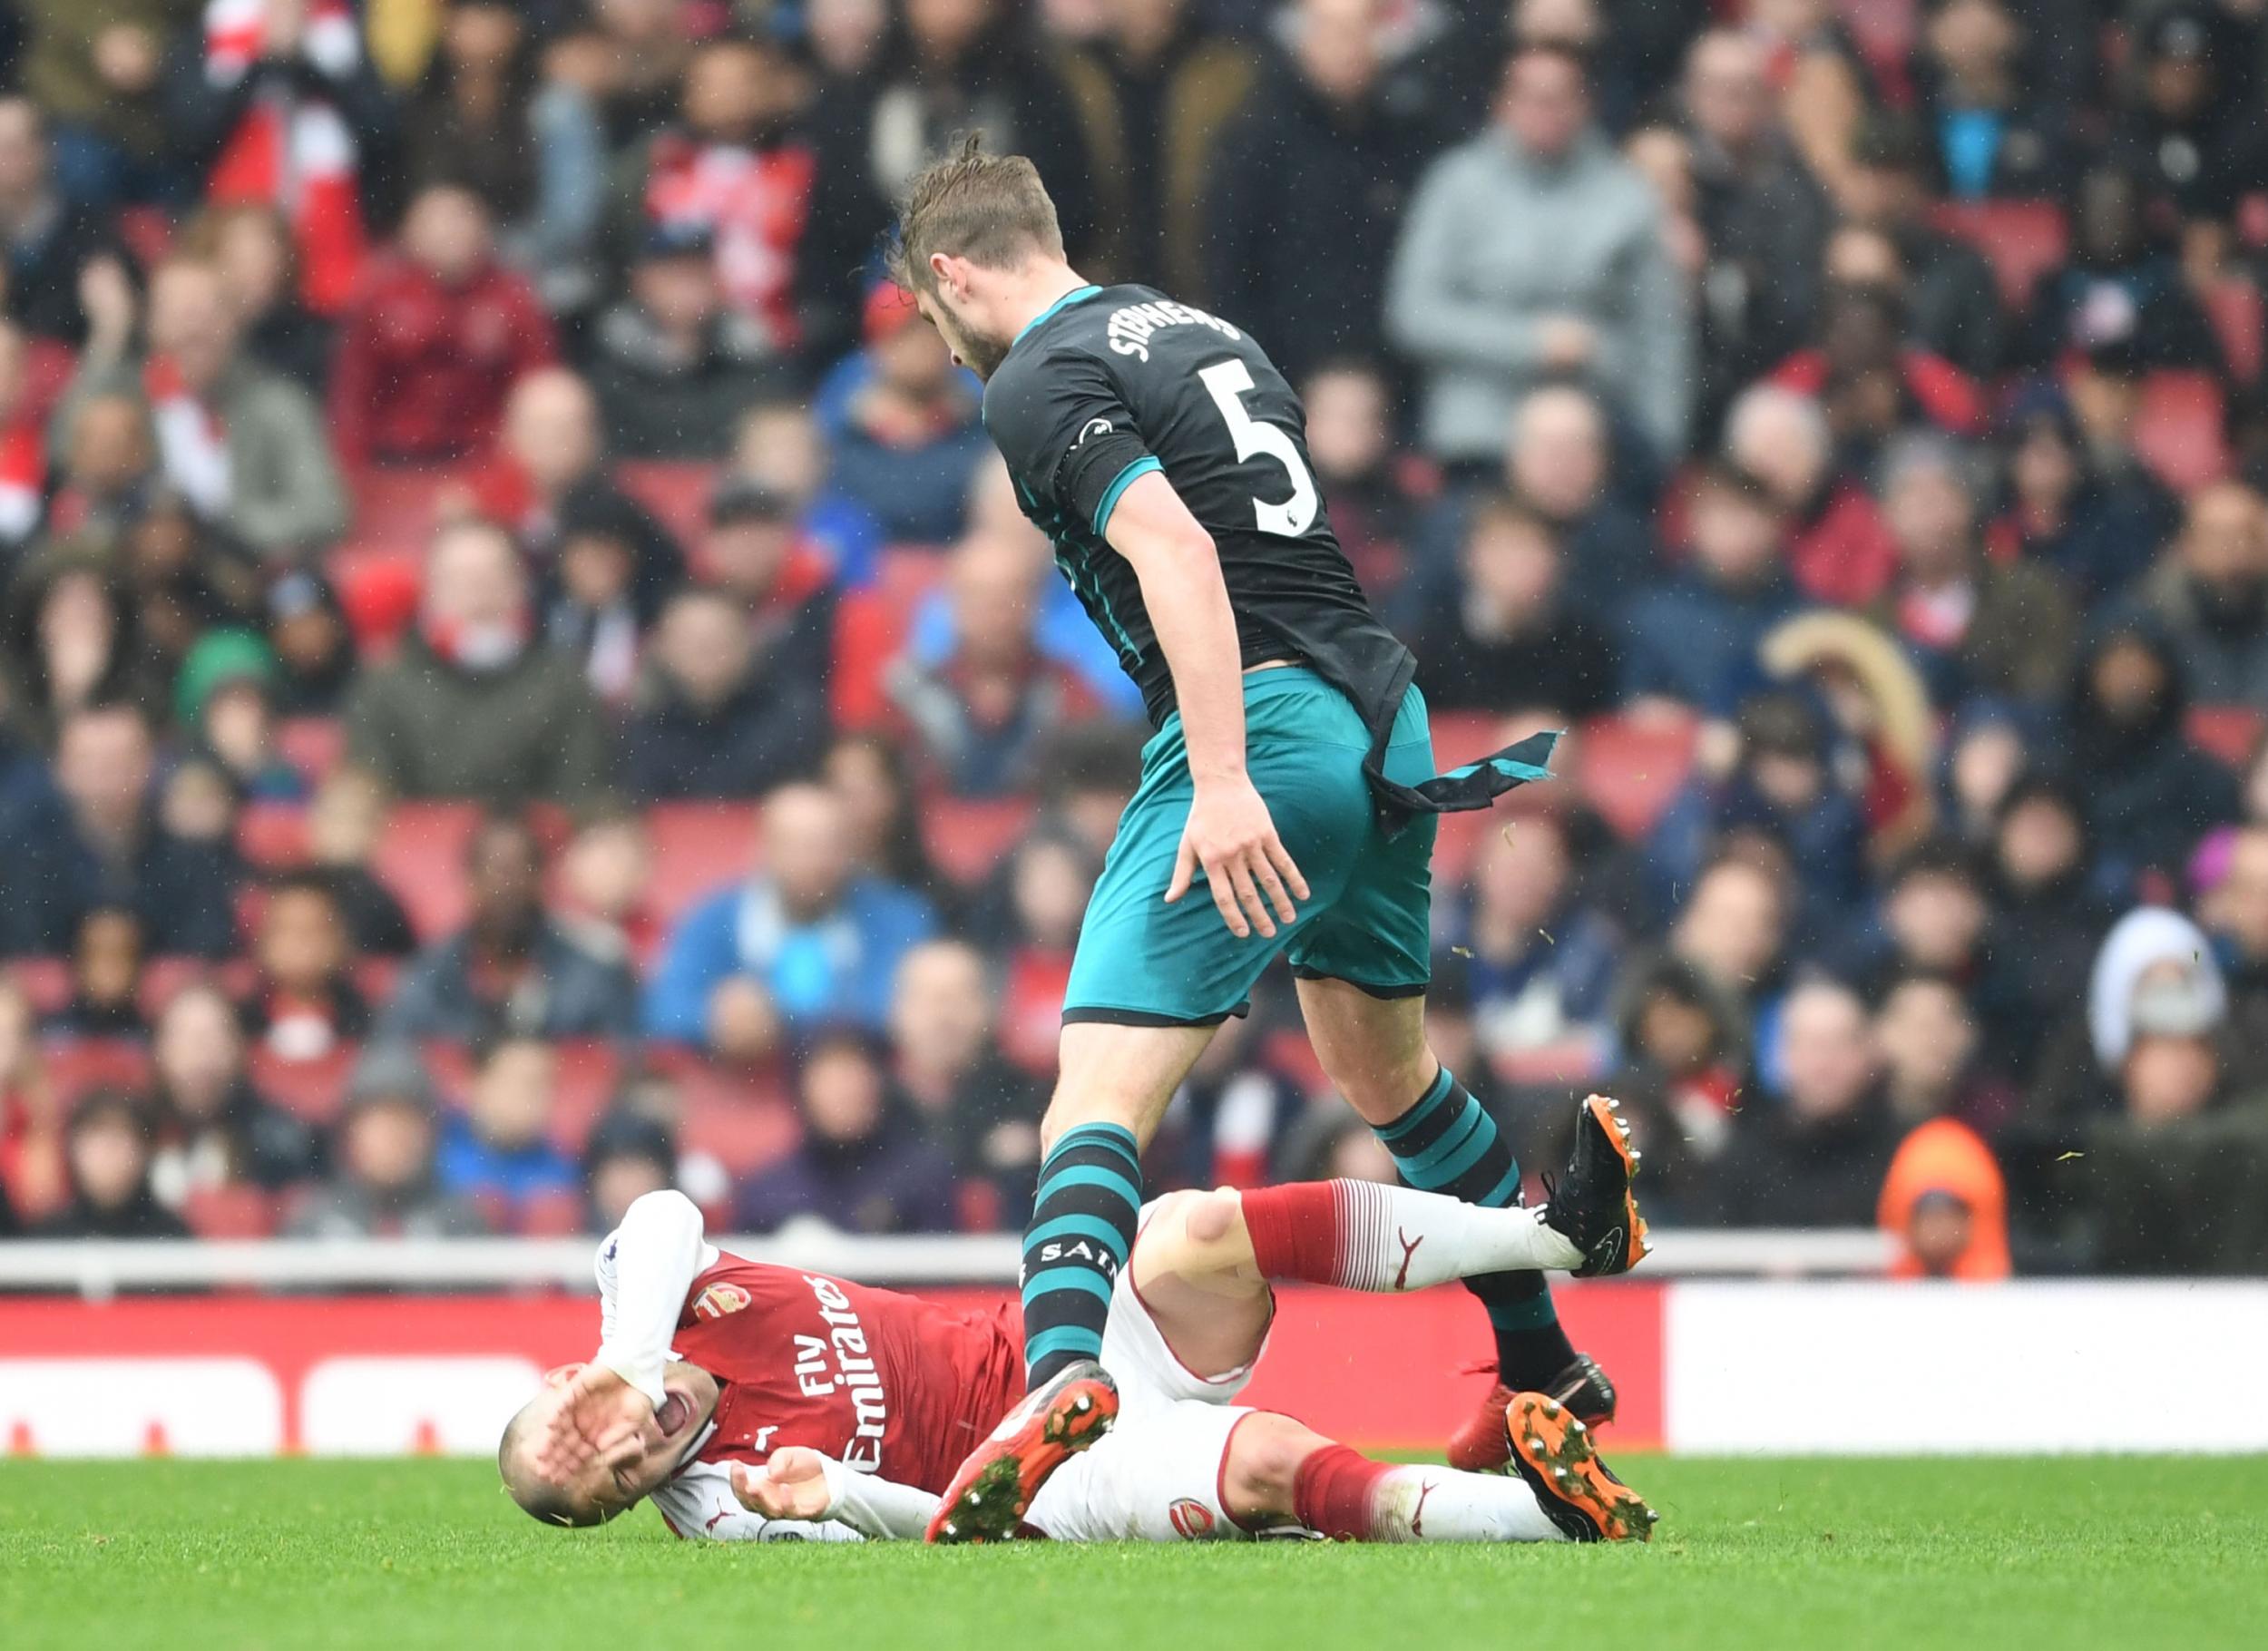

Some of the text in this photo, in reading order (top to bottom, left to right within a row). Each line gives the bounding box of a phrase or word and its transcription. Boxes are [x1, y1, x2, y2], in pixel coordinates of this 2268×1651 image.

[1108, 300, 1241, 363] STEPHENS
[1198, 358, 1317, 537] 5
[794, 1334, 836, 1398] Fly
[802, 1274, 887, 1473] Emirates
